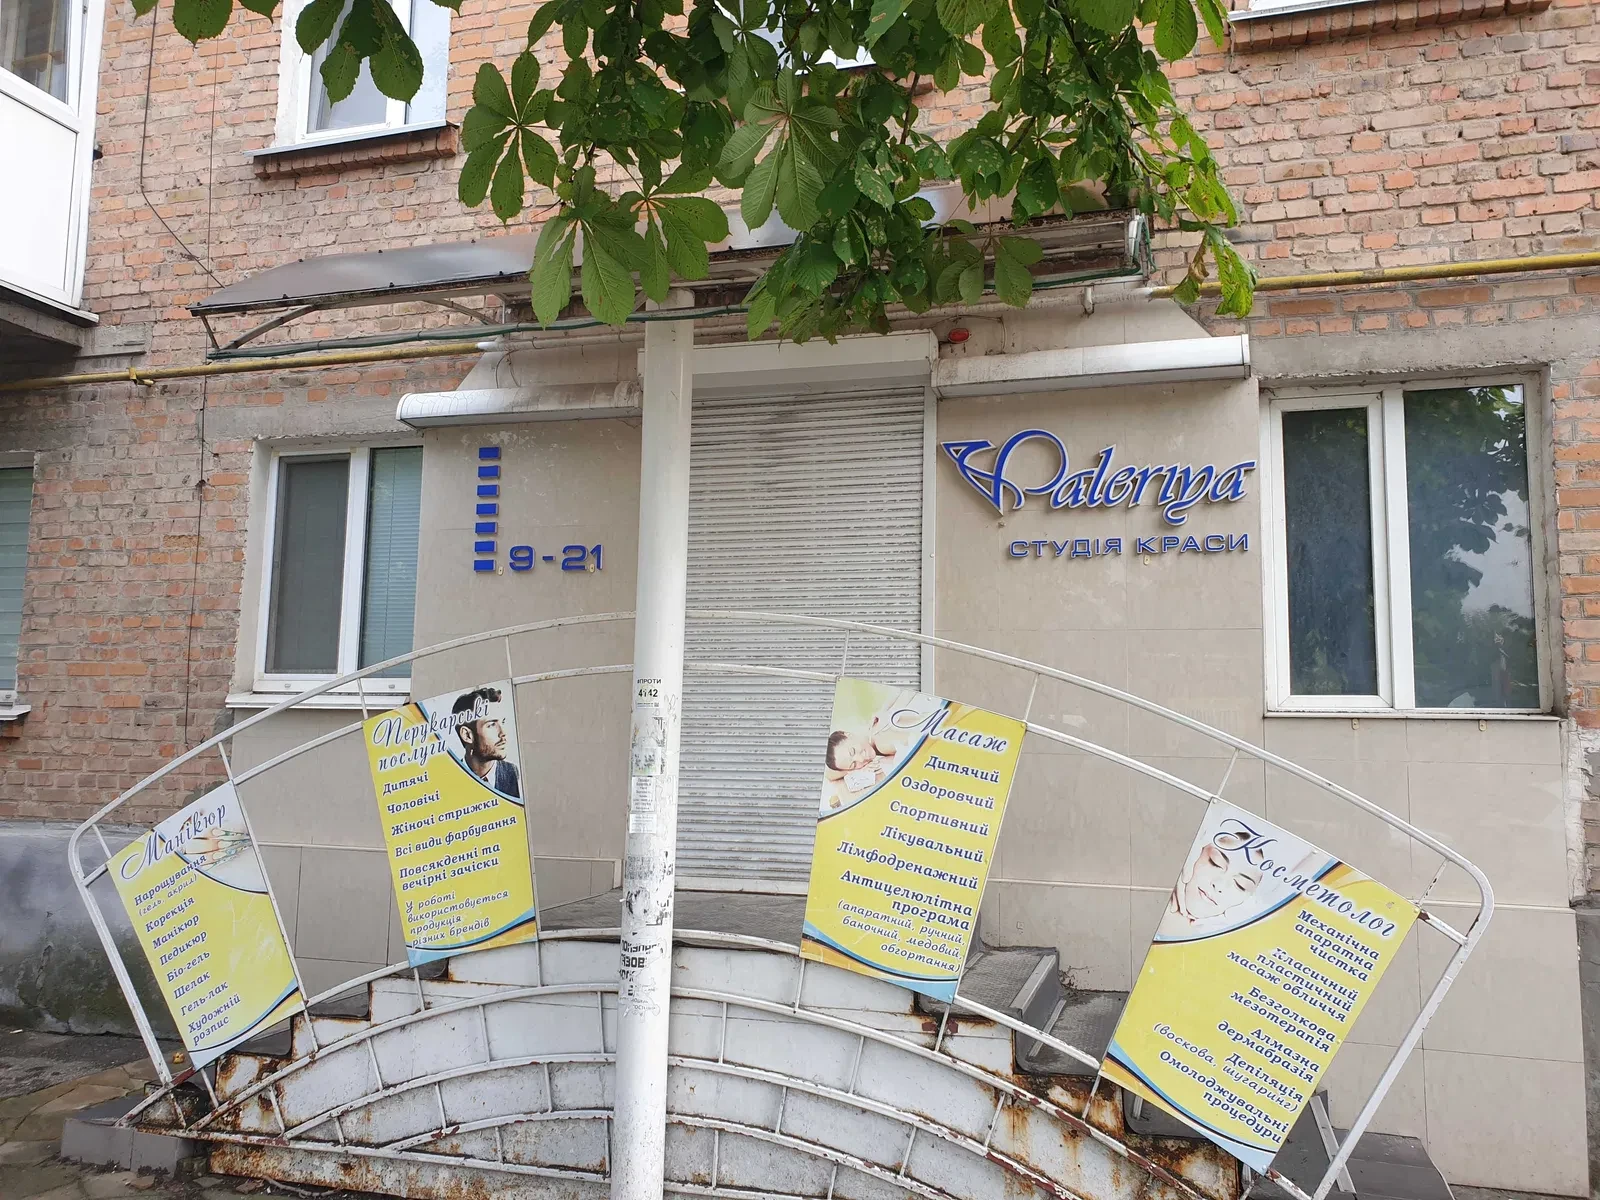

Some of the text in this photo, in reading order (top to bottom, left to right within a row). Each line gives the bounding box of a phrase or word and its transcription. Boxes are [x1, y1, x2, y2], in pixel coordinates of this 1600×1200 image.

[1009, 533, 1249, 558] СТУДІЯ КРАСИ
[373, 698, 490, 748] Перукарські
[891, 708, 1008, 753] Масаж
[378, 740, 448, 771] послуги
[925, 756, 1000, 783] Дитячий
[383, 772, 429, 796] Дитячі
[387, 790, 440, 815] Чоловічі
[901, 776, 995, 810] Оздоровчий
[391, 798, 499, 836] Жіночі стрижки
[890, 800, 989, 836] Спортивний
[121, 804, 227, 881] Манікюр
[395, 815, 517, 858] Всі види фарбування
[881, 826, 983, 864] Лікувальний
[134, 853, 208, 907] Нарощування
[399, 843, 501, 879] Повсякденні та
[402, 857, 499, 891] вечірні зачіски
[837, 841, 979, 890] Лімфодренажний
[1213, 818, 1397, 937] Косметолог
[138, 874, 198, 917] (гель, акрил)
[405, 892, 455, 913] У роботі
[407, 891, 509, 923] використовується
[840, 870, 973, 917] Антицелюлітна
[145, 897, 195, 933] Корекція
[152, 914, 200, 950] Манікюр
[410, 915, 462, 935] продукція
[412, 918, 490, 947] різних брендів
[838, 900, 966, 946] (апаратний, ручний,
[892, 900, 970, 931] програма
[159, 930, 208, 966] Педикюр
[842, 915, 963, 960] баночний, медовий,
[1294, 924, 1374, 972] апаратна
[1297, 909, 1380, 960] Механічна
[166, 951, 211, 983] Біо-гель
[881, 943, 961, 974] обгортання)
[1272, 948, 1359, 1001] Класичний
[1309, 944, 1369, 982] чистка
[173, 971, 211, 999] Шелак
[180, 980, 229, 1016] Гель-лак
[1227, 951, 1346, 1022] масаж обличчя
[1256, 954, 1353, 1012] пластичний
[188, 994, 242, 1033] Художній
[193, 1015, 230, 1046] розпис
[1230, 991, 1330, 1053] мезотерапія
[1248, 986, 1336, 1043] Безголкова
[1154, 1023, 1299, 1112] (воскова, шугаринг)
[1218, 1021, 1314, 1083] дермабразія
[1250, 1028, 1320, 1073] Алмазна
[1160, 1051, 1289, 1133] Омолоджувальні
[1225, 1053, 1304, 1103] Депіляція
[1203, 1092, 1282, 1144] процедури
